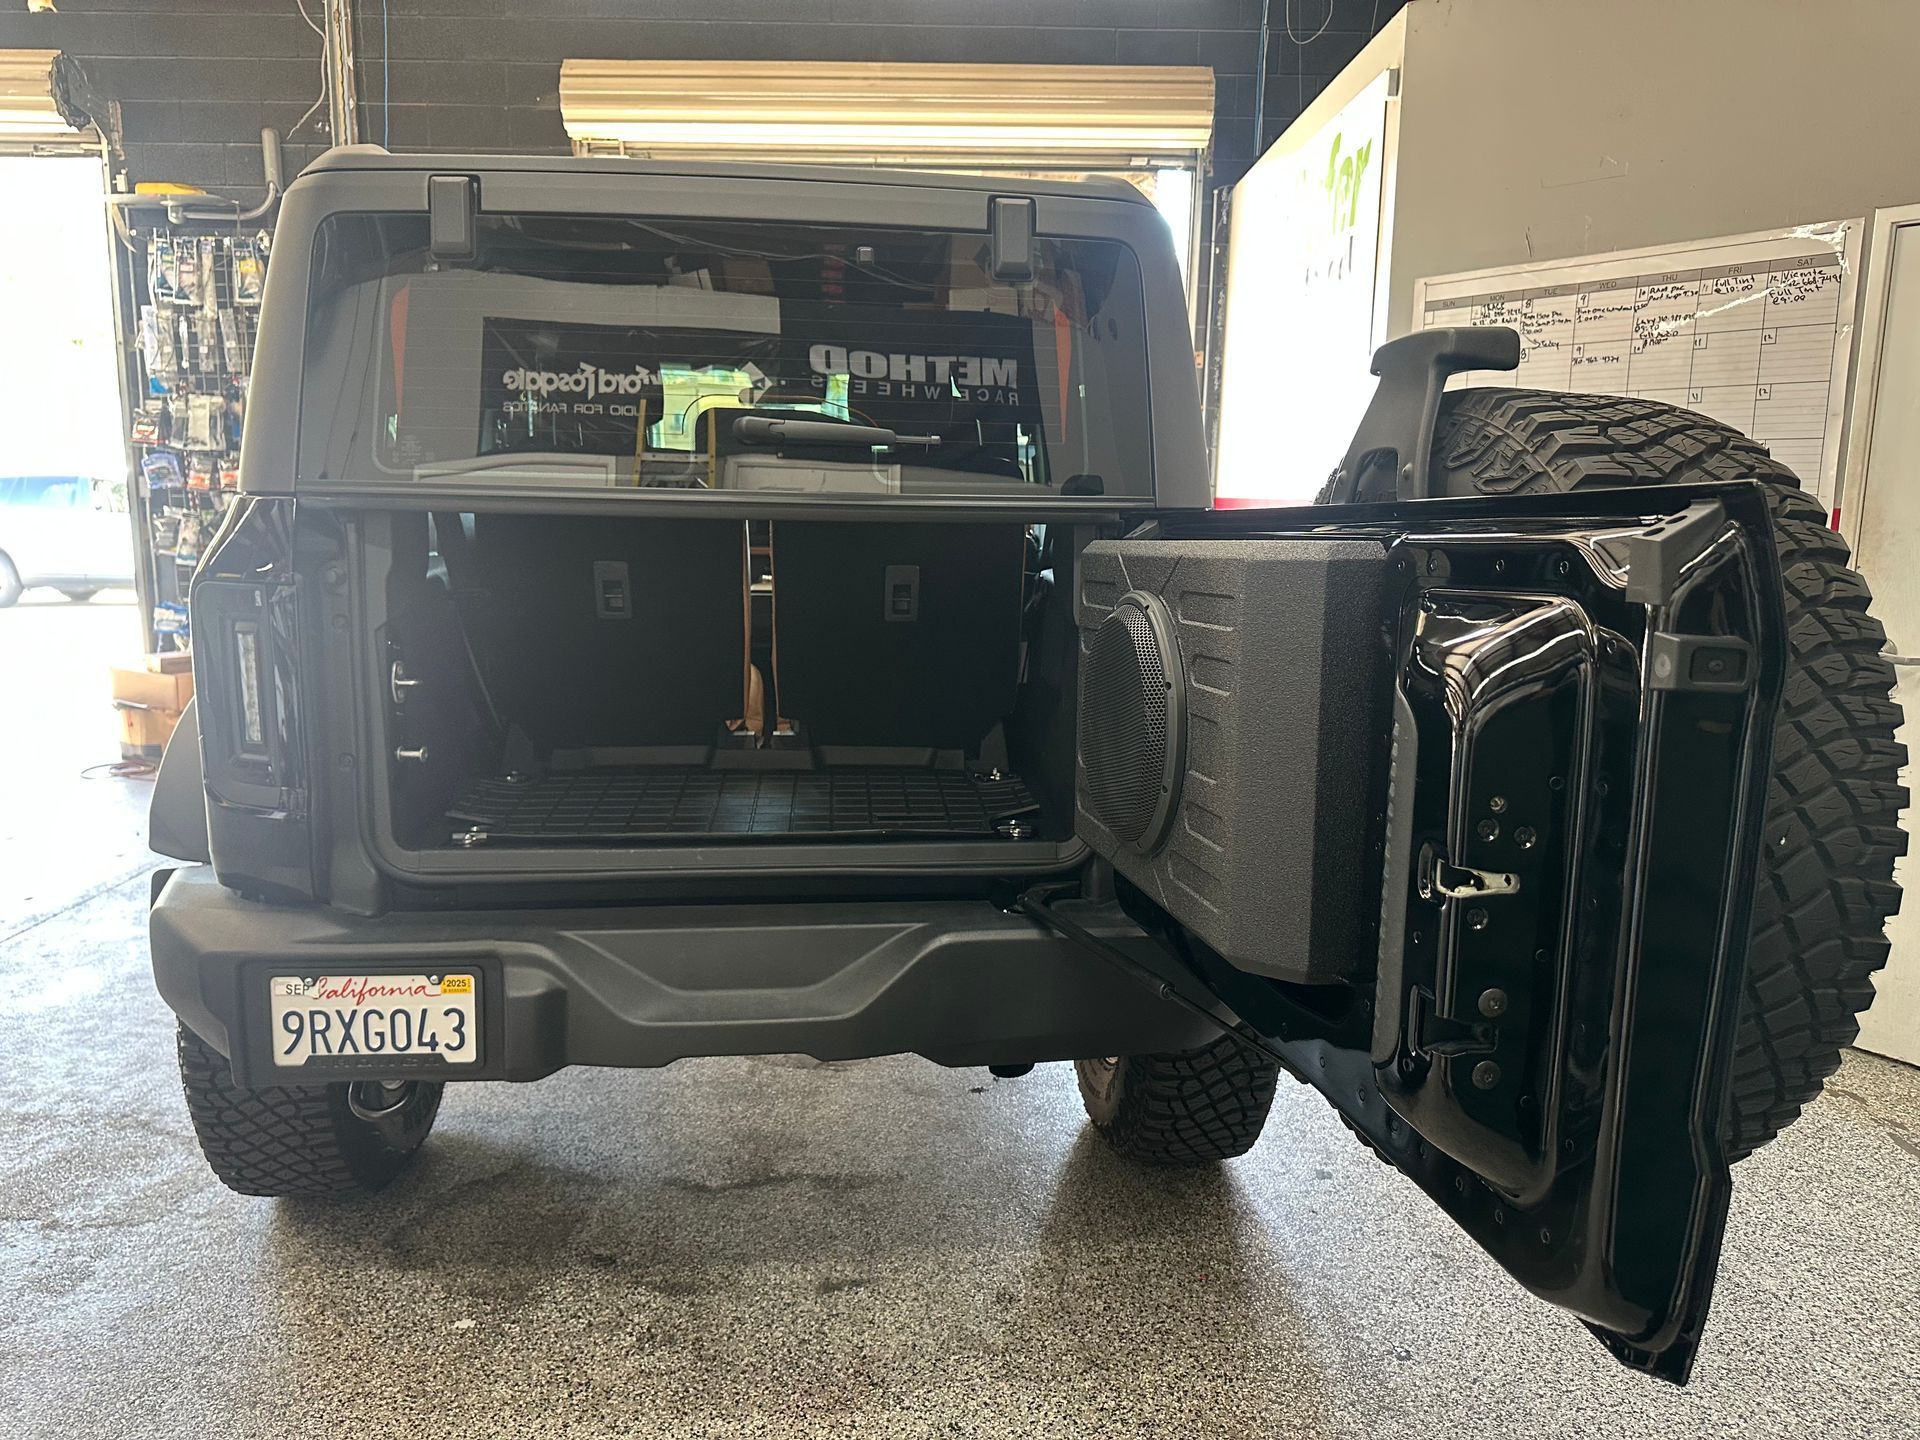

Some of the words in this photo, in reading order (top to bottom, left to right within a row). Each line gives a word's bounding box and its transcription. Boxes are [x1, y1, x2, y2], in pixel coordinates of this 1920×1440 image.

[1797, 258, 1815, 267] SAT
[1728, 267, 1742, 275] FRI
[1662, 275, 1678, 283] THU
[1734, 275, 1755, 285] Tint
[1600, 281, 1617, 289] WED
[1490, 294, 1505, 302] MON
[1525, 299, 1532, 309] 8
[446, 979, 467, 988] 2025
[285, 983, 310, 996] SEP
[312, 976, 442, 1006] California
[282, 1007, 466, 1055] 9RXG043
